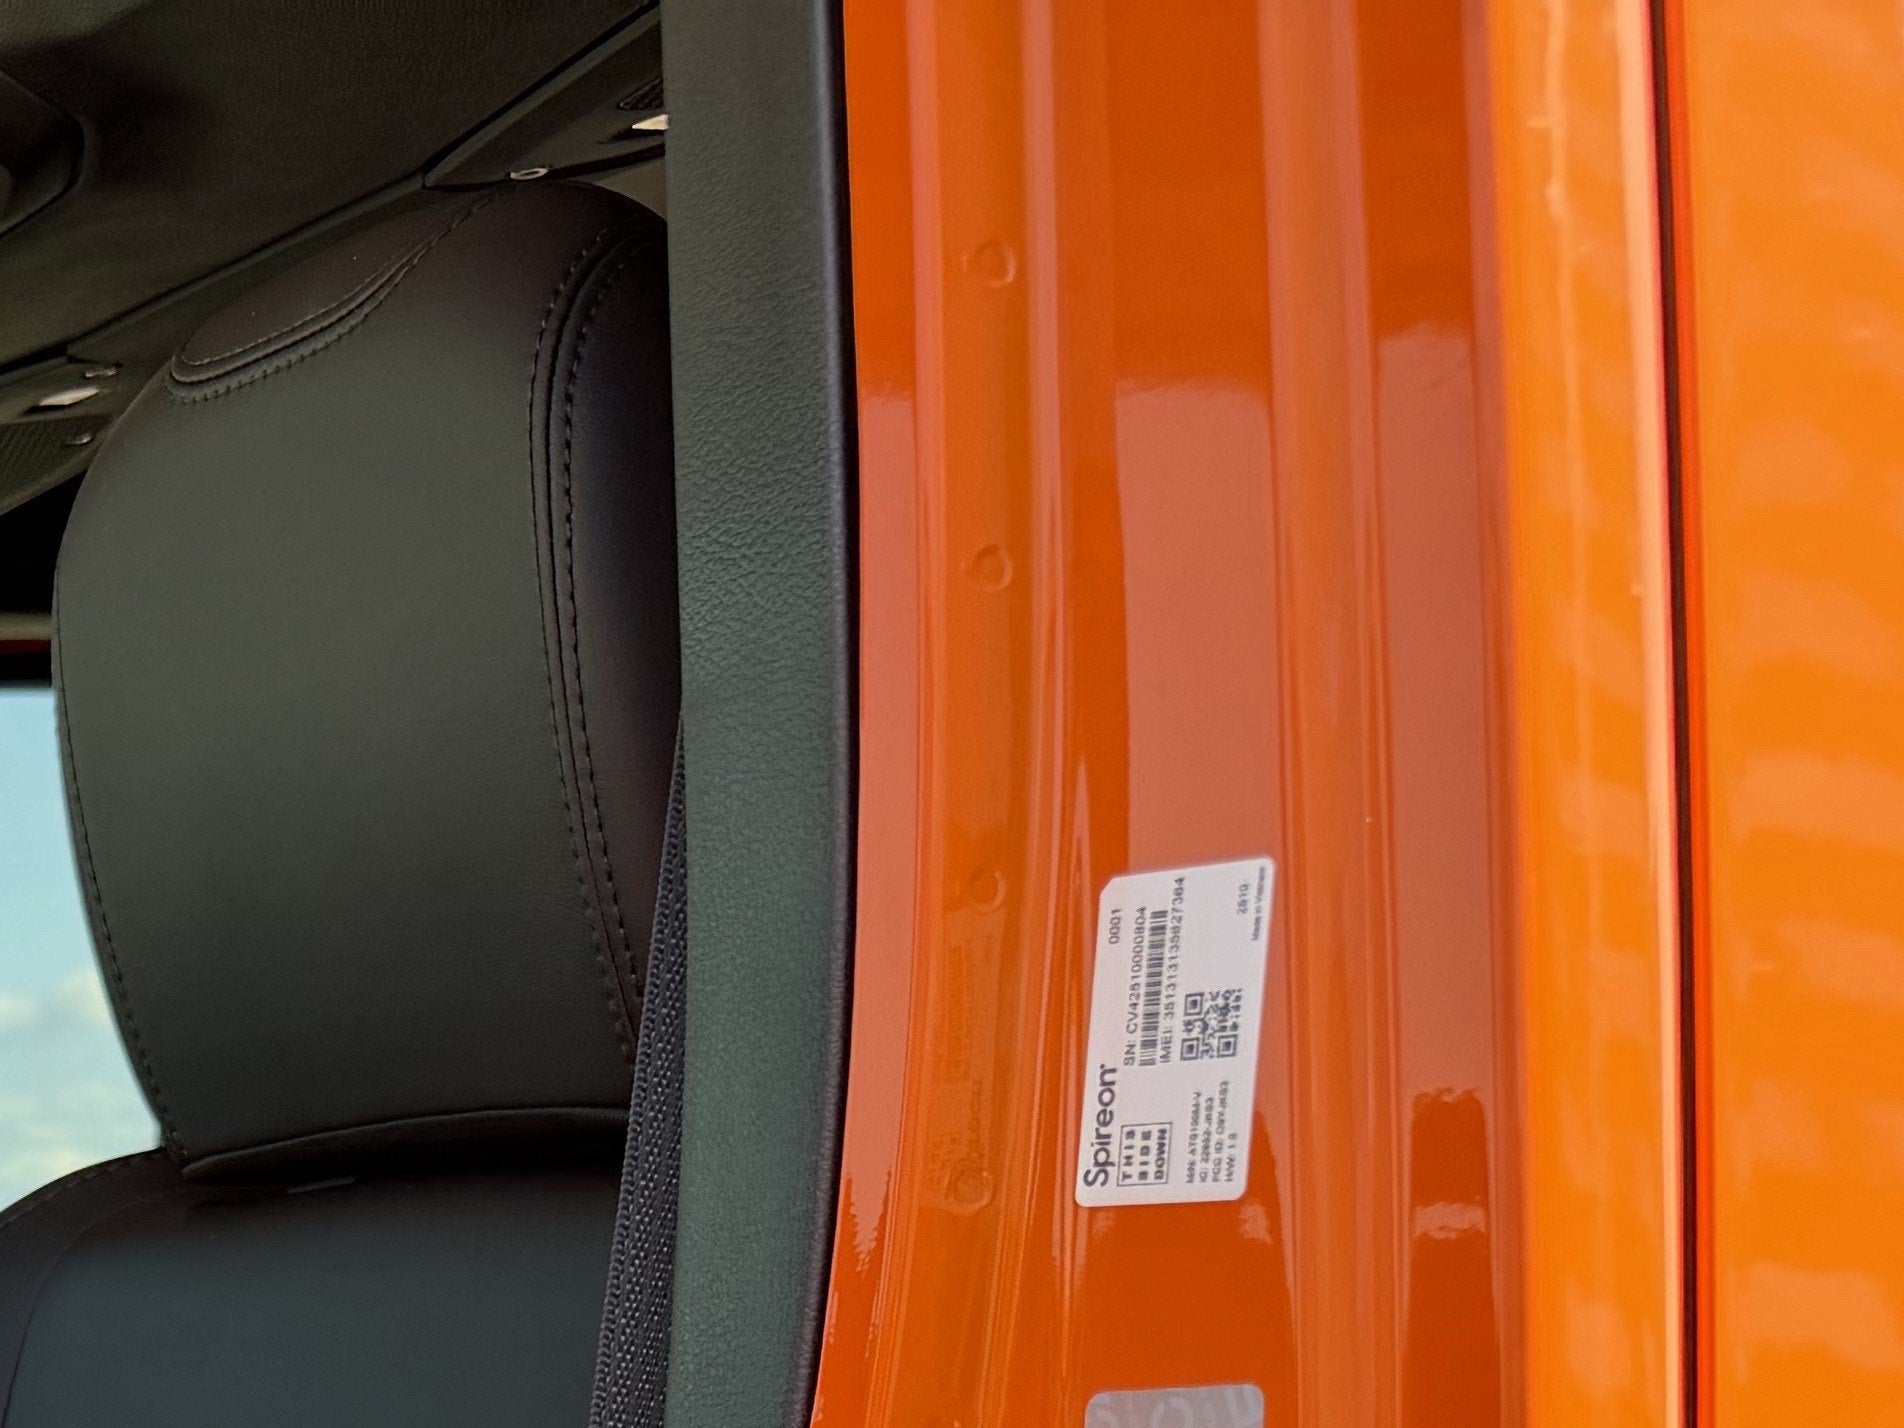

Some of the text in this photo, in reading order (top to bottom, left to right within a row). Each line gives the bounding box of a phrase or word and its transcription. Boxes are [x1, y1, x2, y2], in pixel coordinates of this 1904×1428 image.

[1107, 908, 1122, 944] 0001
[1082, 1067, 1117, 1187] Spireon
[1153, 1127, 1167, 1180] DOWN
[1120, 1128, 1136, 1182] THIS
